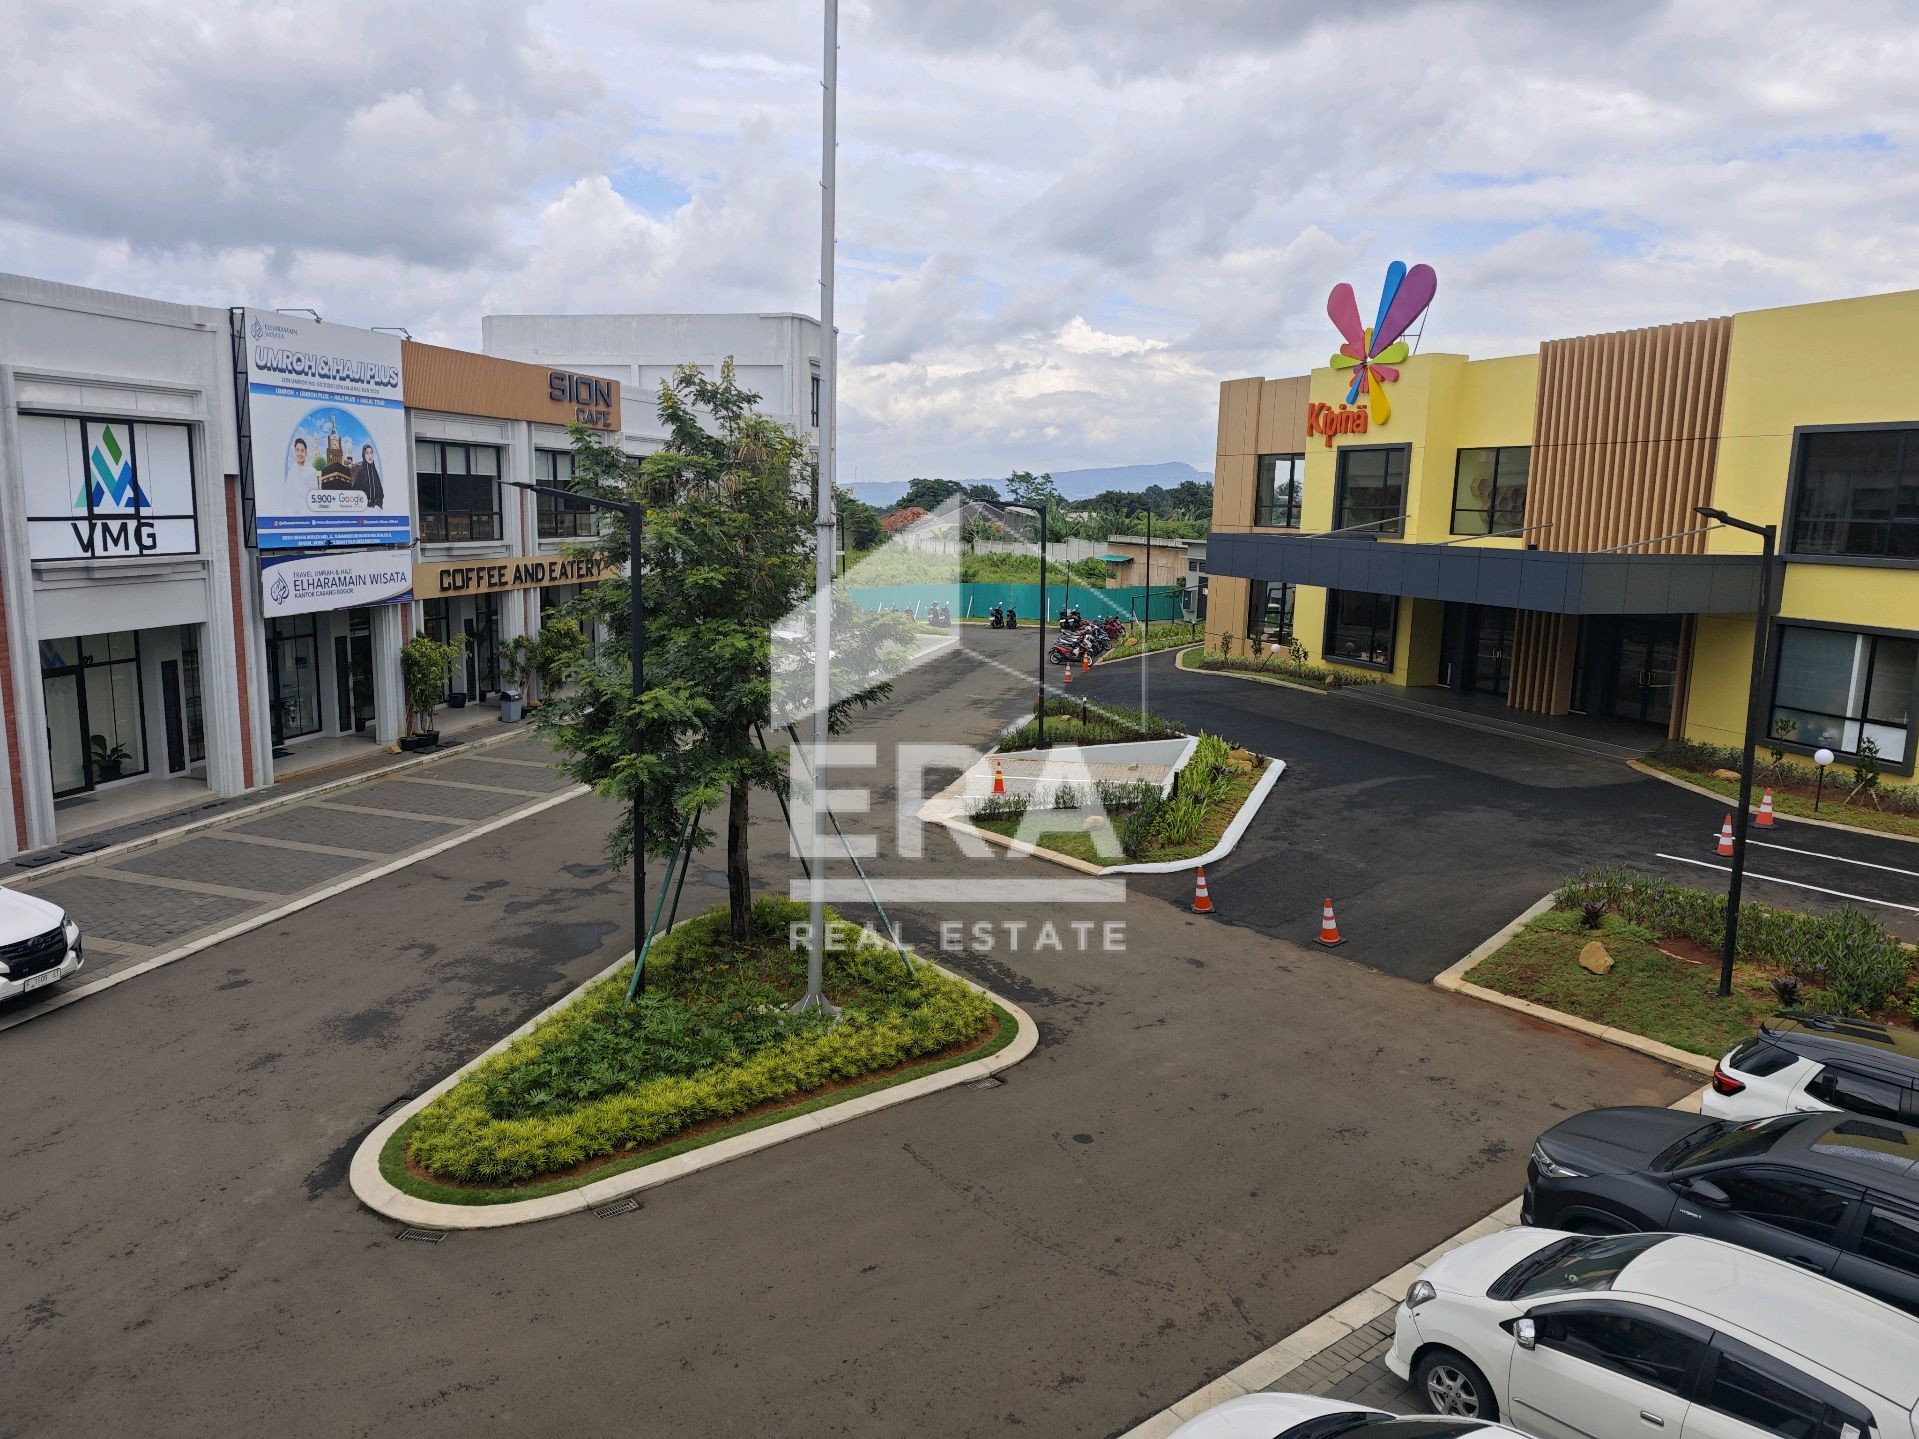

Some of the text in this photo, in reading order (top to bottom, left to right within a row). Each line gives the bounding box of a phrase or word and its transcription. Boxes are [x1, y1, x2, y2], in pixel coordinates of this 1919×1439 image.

[264, 330, 285, 340] WISATA
[255, 345, 399, 389] UMROH & HAJI PLUS
[549, 370, 612, 408] SION
[575, 407, 612, 428] CAFE
[338, 492, 365, 505] Google
[70, 521, 157, 553] VMG
[293, 571, 313, 579] TRAVEL
[314, 569, 334, 577] UMRAH
[293, 571, 407, 592] ELHARAMAIN WISATA
[439, 558, 602, 592] COFFEE AND EATERY
[294, 591, 315, 599] KANTOR
[337, 587, 354, 595] BOGOR
